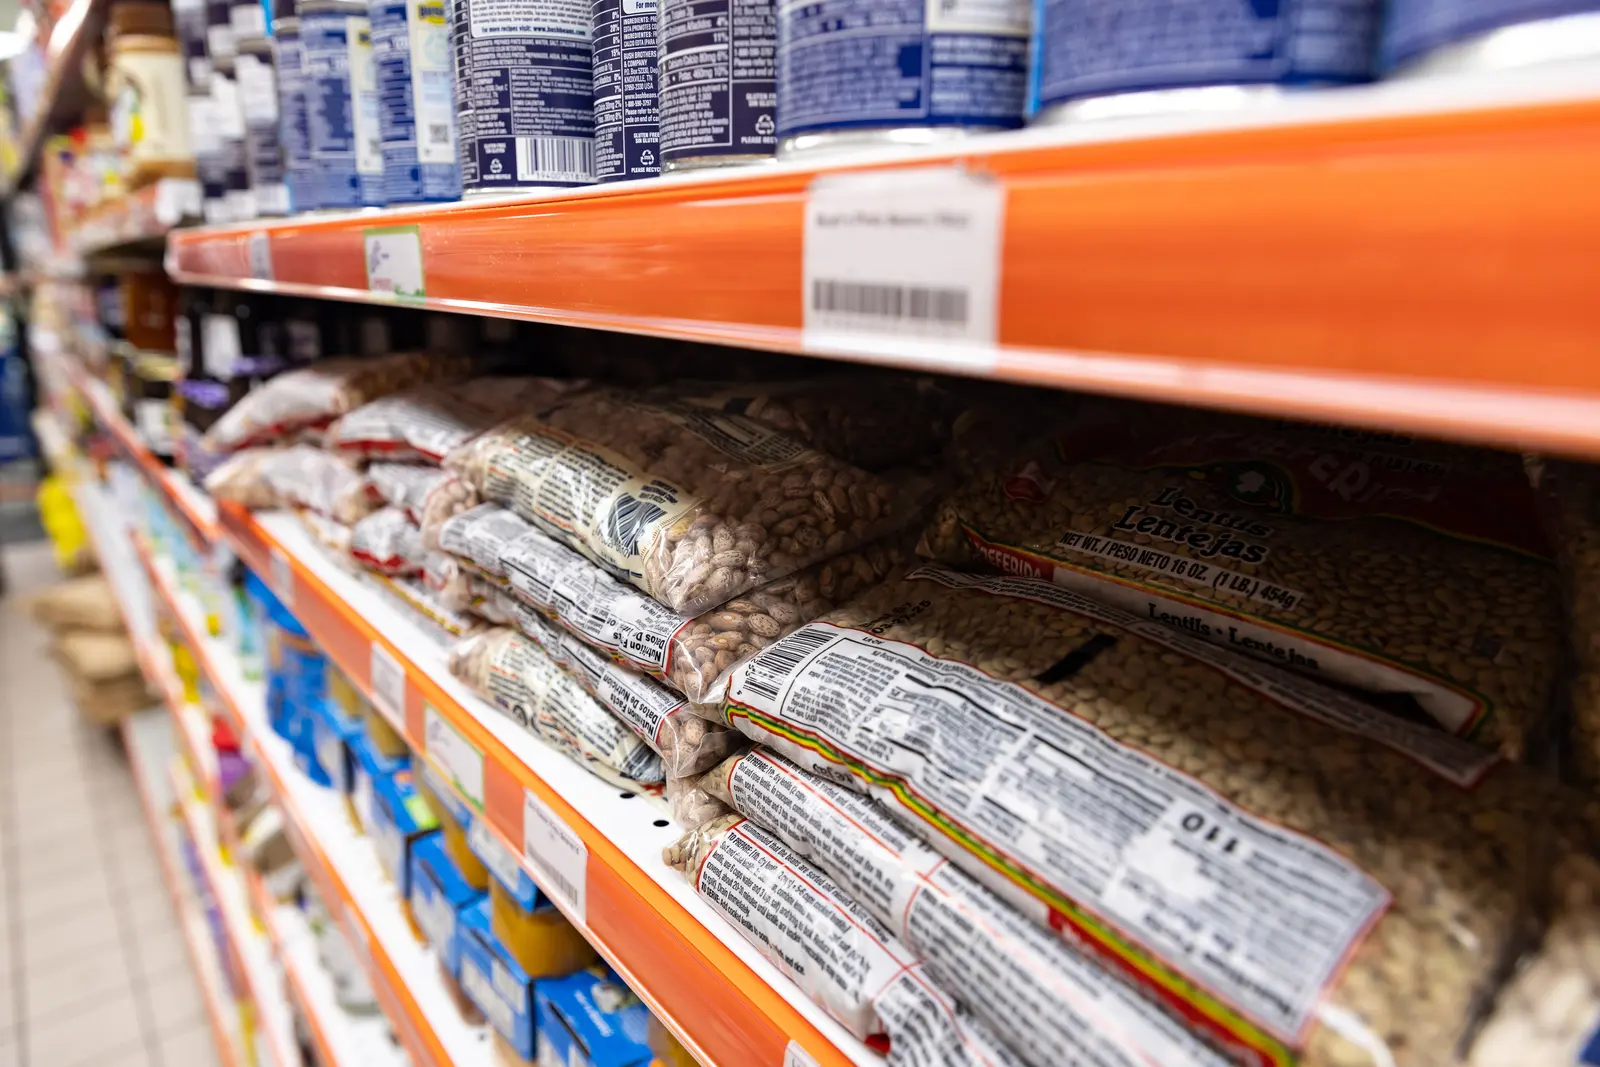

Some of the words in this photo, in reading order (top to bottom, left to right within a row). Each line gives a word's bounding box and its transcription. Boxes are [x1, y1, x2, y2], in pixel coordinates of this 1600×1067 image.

[501, 25, 518, 34] recipes
[534, 26, 586, 36] www.bushbeans.com
[624, 16, 650, 25] INGREDIENTS:
[624, 32, 652, 40] INGREDIENTES:
[624, 75, 646, 83] KNOXVILLE,
[625, 91, 658, 99] www.bushbeans.
[1114, 505, 1269, 565] Lentejas
[1060, 532, 1084, 548] NET
[1082, 536, 1101, 552] WT.
[1107, 543, 1137, 560] PESO
[1137, 550, 1169, 568] NETO
[1170, 559, 1187, 573] 16
[1187, 563, 1207, 580] OZ.
[1212, 571, 1229, 587] (1
[1230, 576, 1258, 597] LB.)
[1261, 586, 1294, 608] 454g
[645, 634, 664, 649] Datos
[1147, 603, 1211, 639] Lentils
[1228, 626, 1321, 670] Lentejas
[630, 641, 661, 661] Nutrition
[603, 675, 629, 700] Nutricion
[610, 693, 626, 712] Facts
[630, 696, 639, 708] De
[627, 708, 653, 734] Nutrition
[639, 703, 658, 724] Datos
[745, 768, 753, 776] and
[750, 757, 768, 771] PREPARE:
[779, 777, 792, 790] lentils
[835, 796, 847, 805] and
[726, 847, 736, 856] and
[742, 821, 771, 845] recommended
[768, 842, 781, 852] that
[777, 848, 787, 856] the
[785, 853, 800, 866] beans
[798, 864, 808, 872] are
[806, 871, 825, 885] sorted
[822, 882, 835, 892] and
[702, 871, 706, 879] to
[707, 862, 722, 878] covered,
[722, 873, 731, 885] about
[712, 850, 724, 865] lentils,
[729, 864, 735, 872] 6
[732, 868, 742, 879] cups
[742, 876, 753, 887] water
[752, 884, 760, 894] and
[759, 888, 764, 896] 3
[727, 832, 736, 840] TO
[732, 837, 752, 853] PREPARE:
[795, 884, 806, 895] 5-6
[802, 892, 815, 904] cups
[701, 881, 706, 892] TO
[708, 888, 718, 902] SERVE:
